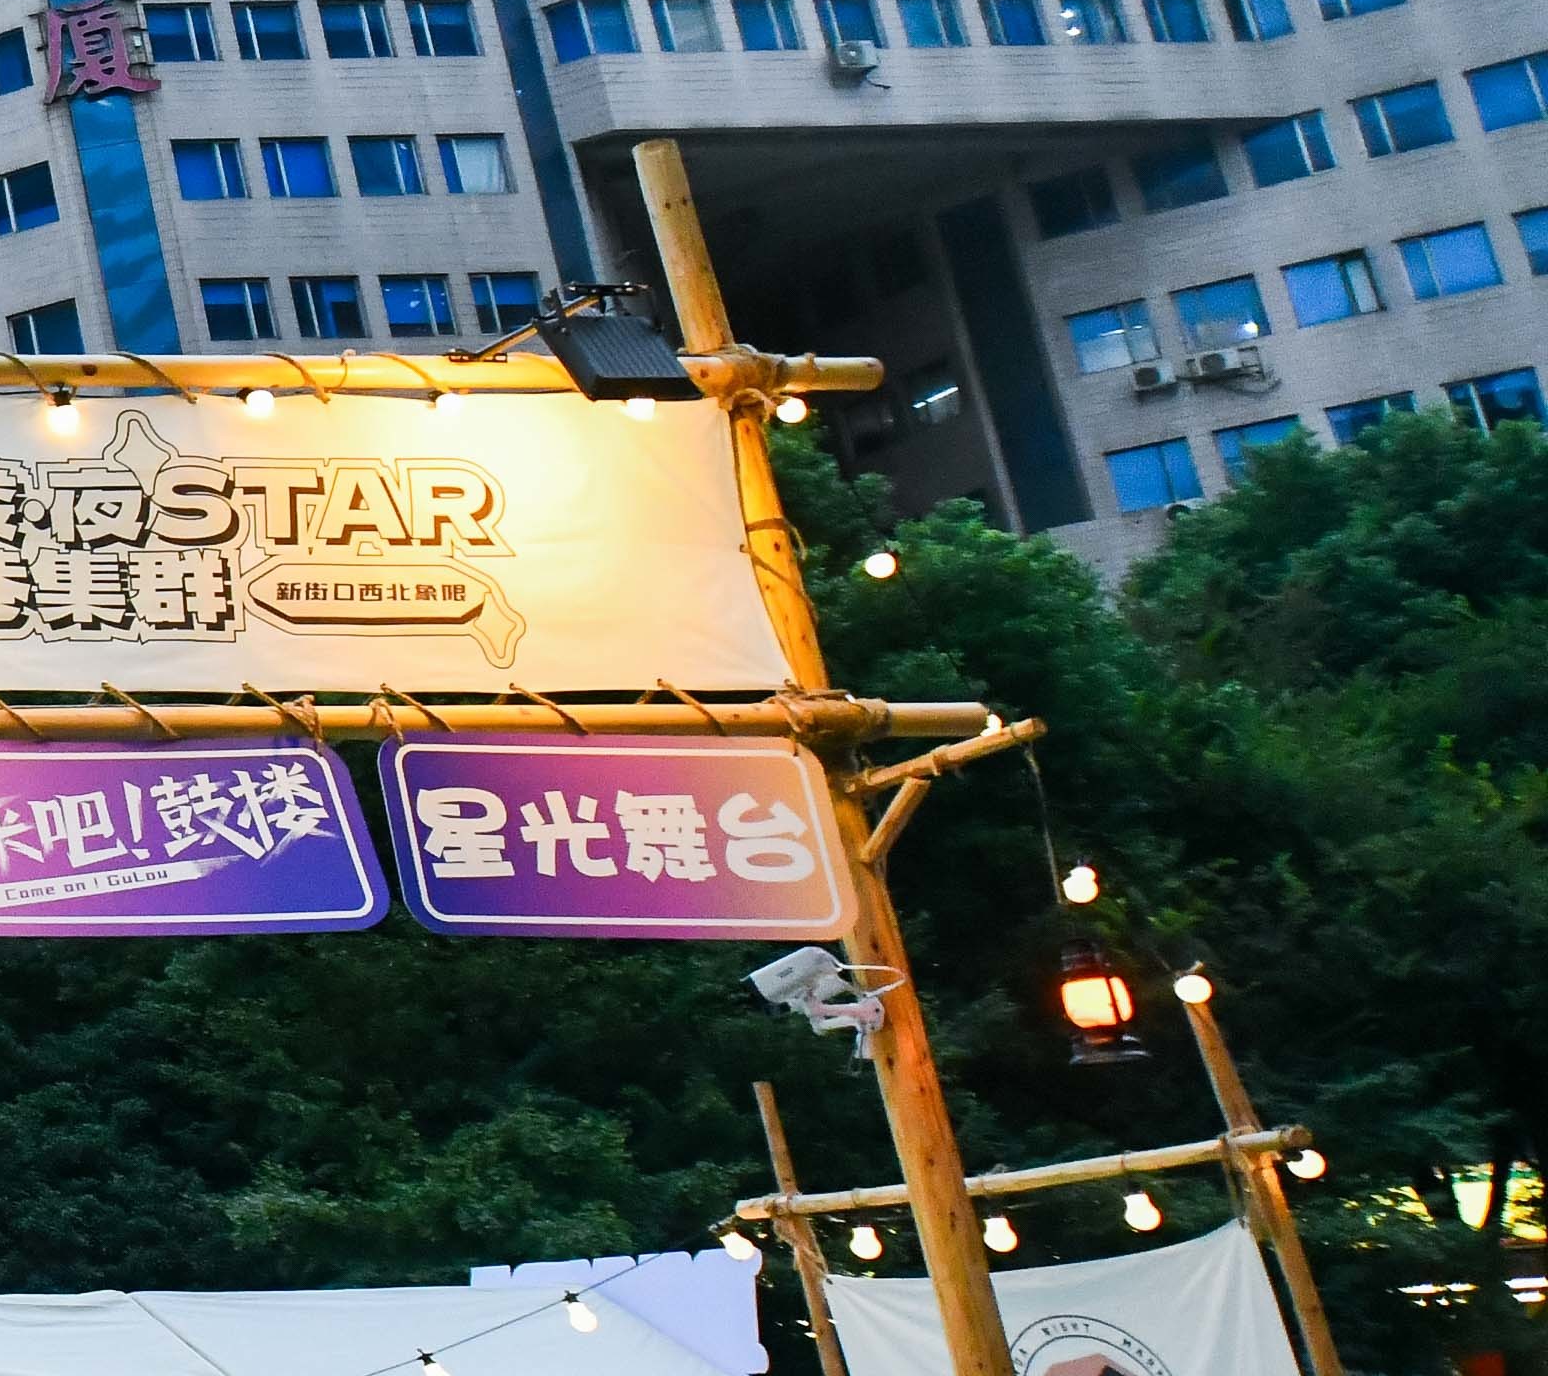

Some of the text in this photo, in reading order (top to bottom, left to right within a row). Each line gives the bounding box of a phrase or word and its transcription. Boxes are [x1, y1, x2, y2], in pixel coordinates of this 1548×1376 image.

[275, 582, 467, 601] 新街口西北象限
[415, 786, 816, 885] 星光舞台
[4, 885, 56, 902] Come
